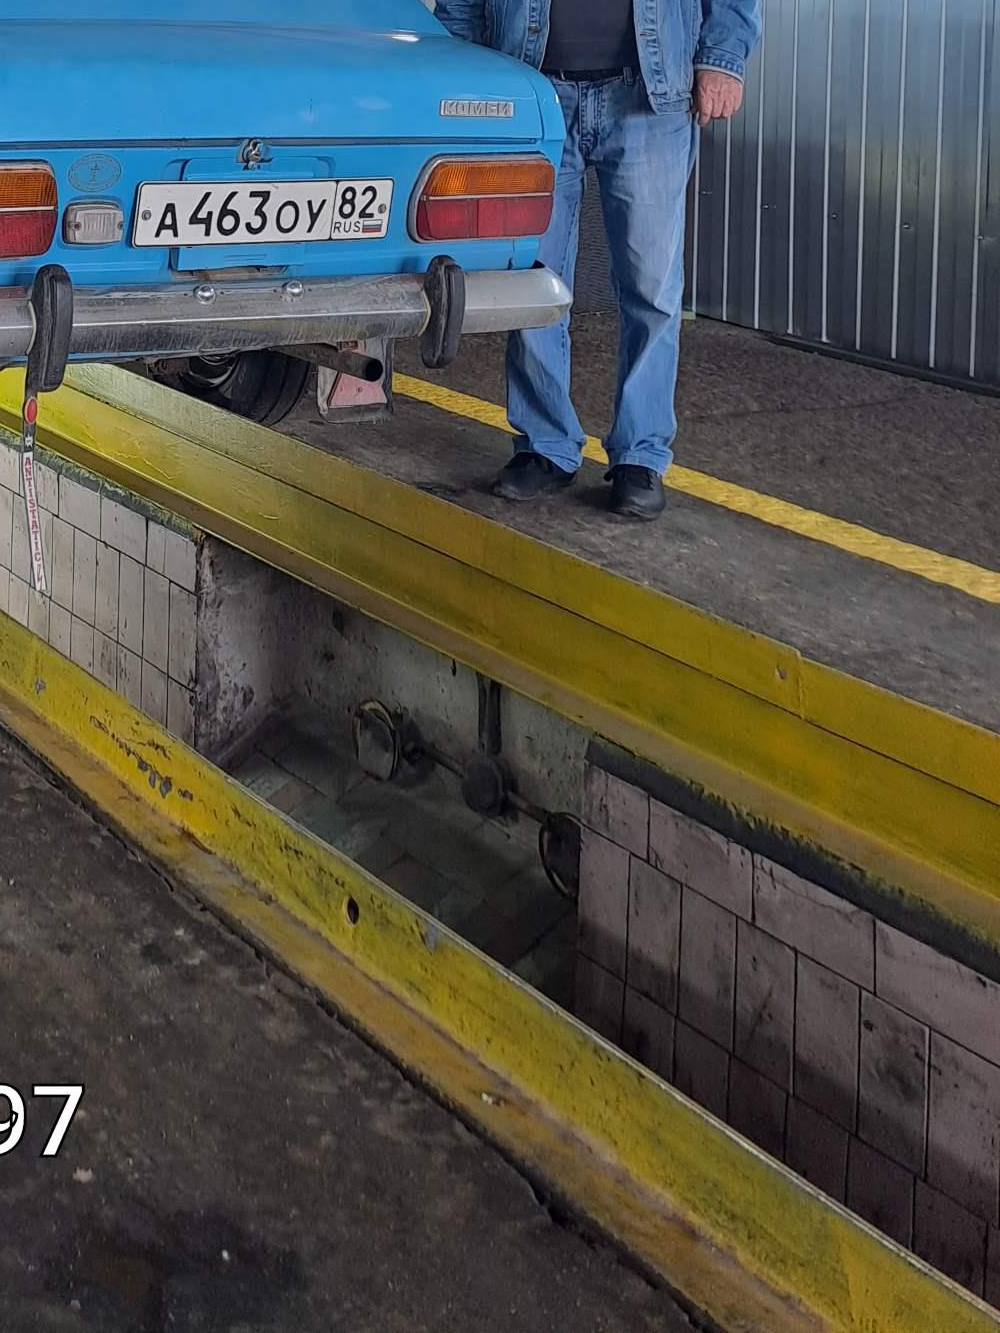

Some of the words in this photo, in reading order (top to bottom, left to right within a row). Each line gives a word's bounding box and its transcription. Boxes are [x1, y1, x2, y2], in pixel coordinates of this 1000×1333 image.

[338, 184, 377, 220] 82
[333, 220, 361, 235] RUS
[23, 456, 42, 563] ANTISTATIC
